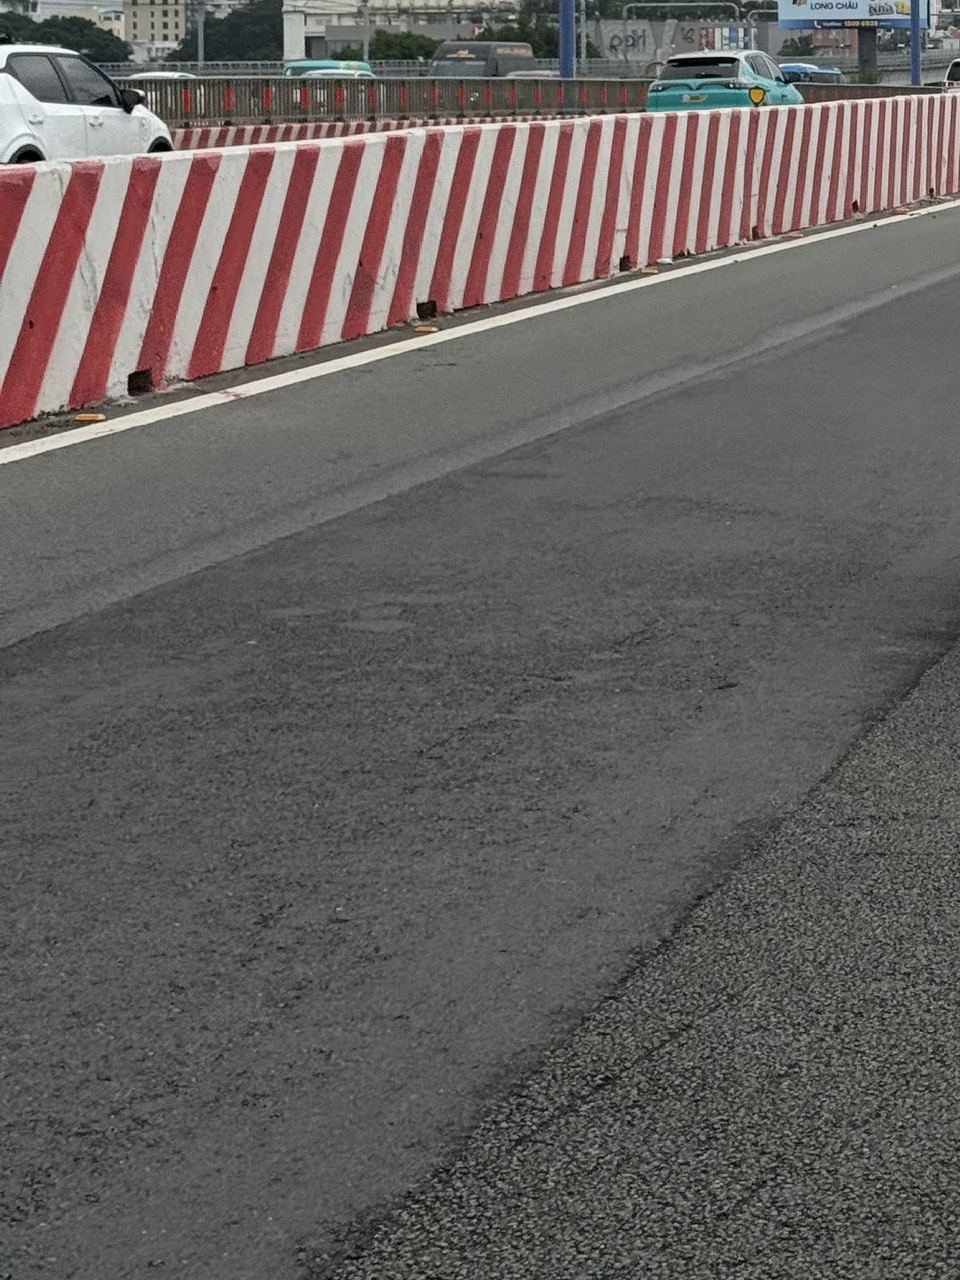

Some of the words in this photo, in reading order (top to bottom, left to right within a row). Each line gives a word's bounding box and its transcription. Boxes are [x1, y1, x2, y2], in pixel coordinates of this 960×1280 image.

[810, 2, 834, 10] LONG
[835, 1, 858, 10] CHÂU
[868, 2, 895, 17] Nhà
